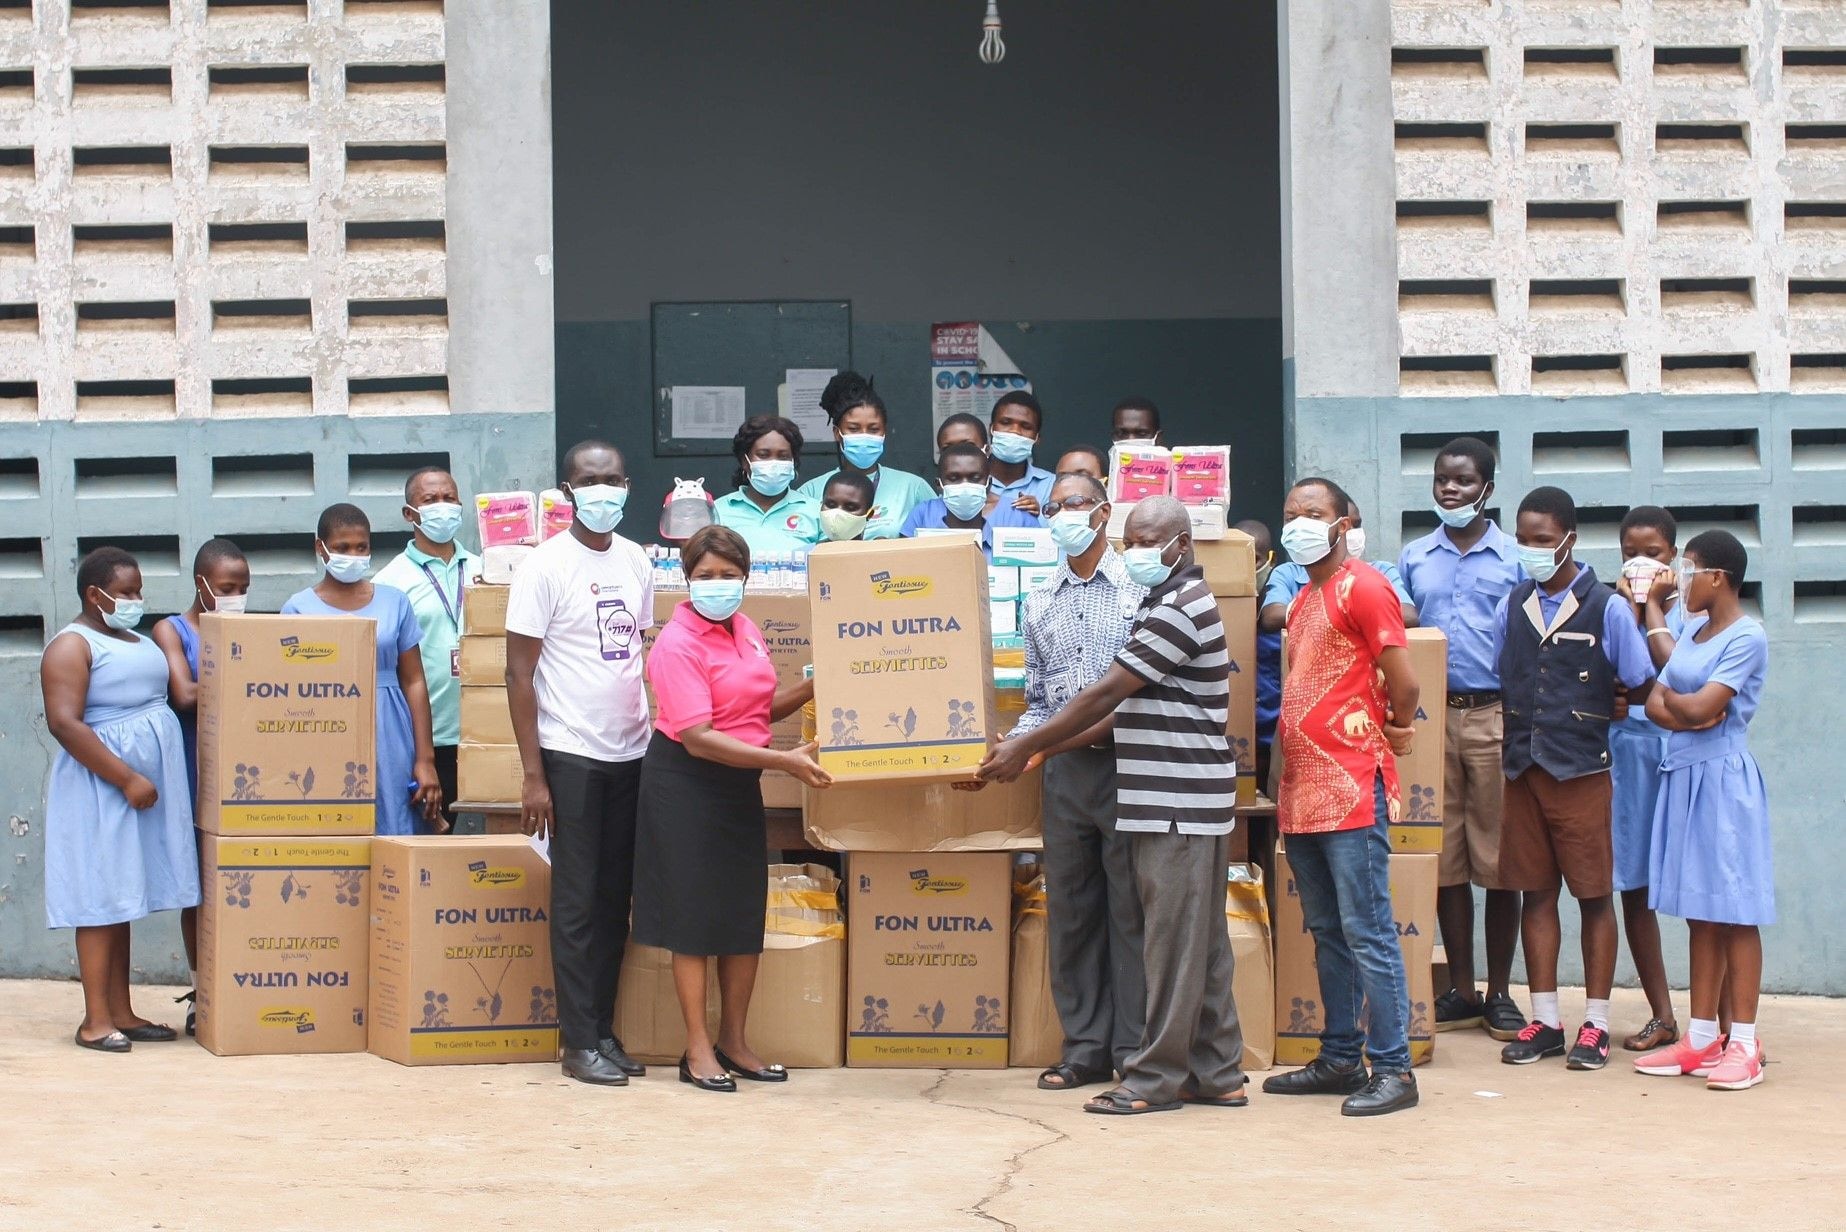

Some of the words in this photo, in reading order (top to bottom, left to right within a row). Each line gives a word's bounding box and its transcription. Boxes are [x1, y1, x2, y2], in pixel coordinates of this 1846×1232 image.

[937, 336, 963, 345] STAY
[937, 346, 949, 355] IN
[951, 346, 978, 355] SCHO
[838, 621, 883, 639] FON
[892, 616, 962, 635] ULTRA
[778, 638, 811, 646] ULTRA
[879, 645, 913, 657] Smooth
[851, 656, 948, 675] SERVIETTES
[246, 683, 289, 698] FON
[298, 683, 361, 698] ULTRA
[257, 720, 347, 733] SERVIETTES
[846, 760, 860, 768] The
[862, 759, 888, 768] Gentle
[890, 757, 914, 766] Touch
[922, 756, 927, 765] 1
[943, 755, 949, 763] 2
[317, 814, 322, 822] 1
[336, 814, 342, 822] 2
[287, 849, 309, 857] Touch
[311, 849, 335, 857] Gentle
[435, 908, 477, 924] FON
[485, 907, 548, 923] ULTRA
[875, 915, 918, 931] FON
[927, 916, 994, 932] ULTRA
[248, 936, 340, 950] SERVIETTES
[445, 945, 534, 959] SERVIETTES
[885, 953, 978, 967] SERVIETTES
[233, 972, 298, 987] ULTRA
[307, 971, 349, 987] FON
[449, 1041, 473, 1049] Gentle
[474, 1040, 497, 1048] Touch
[504, 1039, 509, 1047] 1
[522, 1039, 529, 1047] 2
[874, 1046, 887, 1054] The
[889, 1046, 914, 1054] Gentle
[916, 1046, 939, 1054] Touch
[947, 1047, 952, 1055] 1
[966, 1047, 973, 1055] 2
